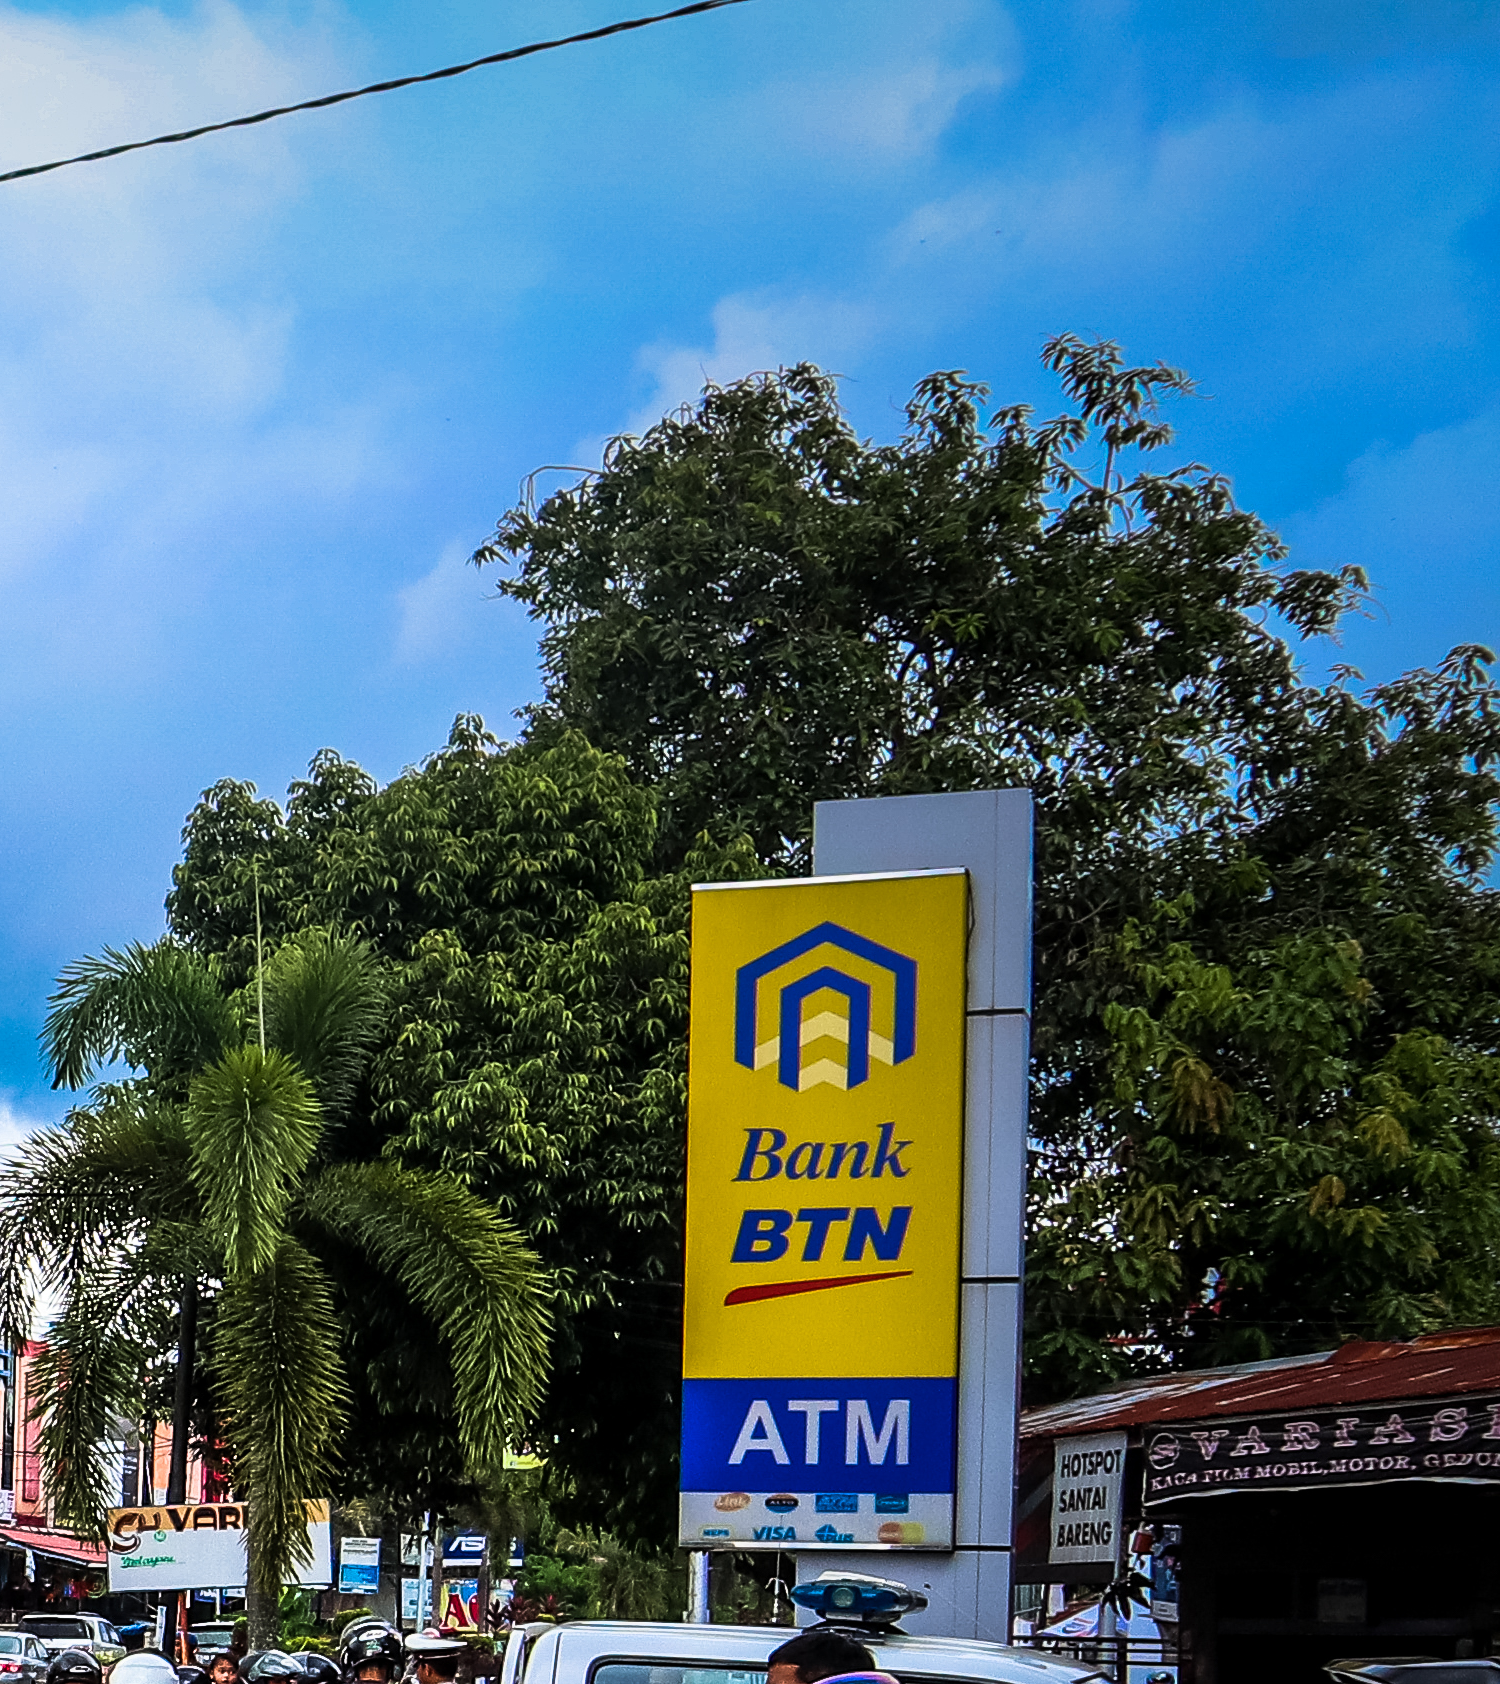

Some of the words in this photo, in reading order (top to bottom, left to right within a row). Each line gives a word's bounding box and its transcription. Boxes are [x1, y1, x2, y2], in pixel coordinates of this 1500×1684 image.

[731, 1121, 913, 1182] Bank
[731, 1206, 914, 1263] BTN
[728, 1400, 910, 1465] ATM
[1061, 1448, 1123, 1478] HOTSPOT
[1059, 1486, 1108, 1514] SANTAI
[753, 1526, 797, 1540] VISA
[1057, 1521, 1113, 1548] BARENG
